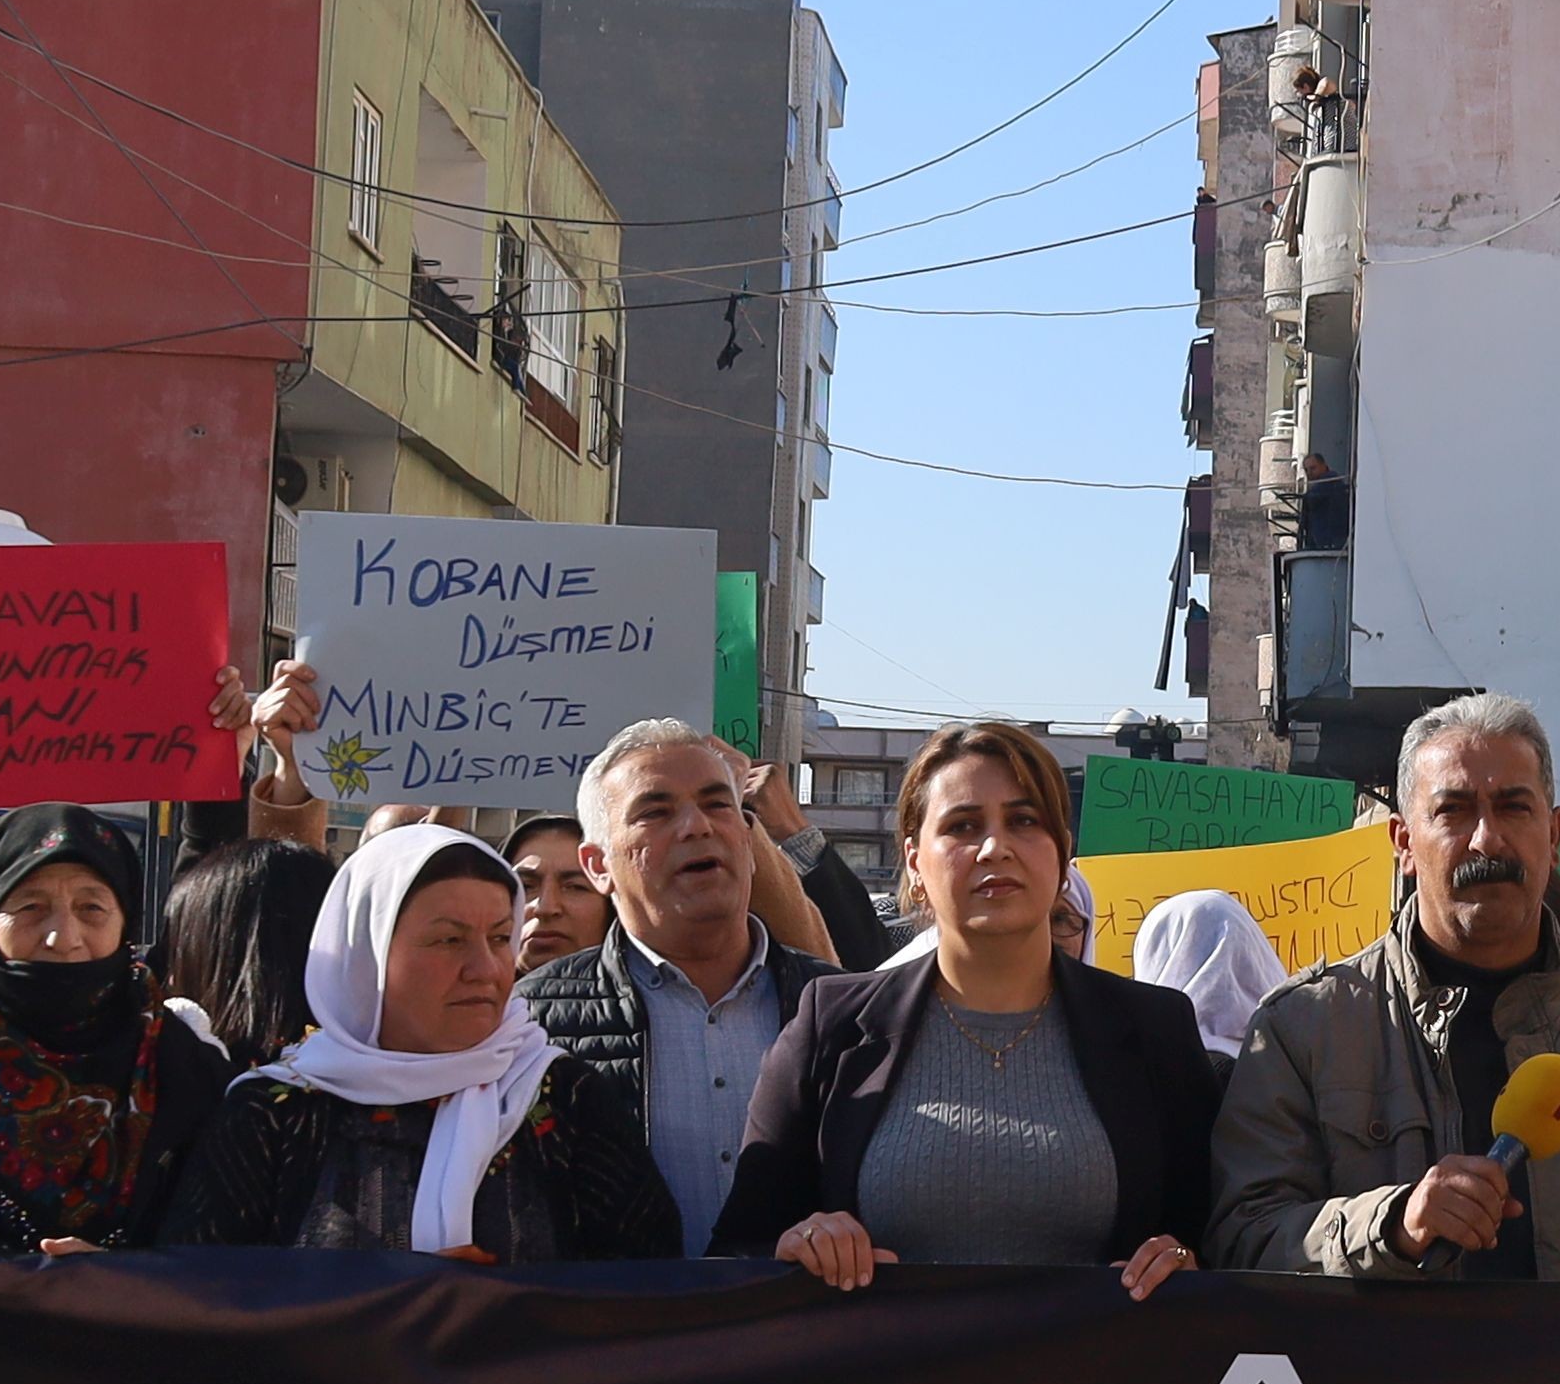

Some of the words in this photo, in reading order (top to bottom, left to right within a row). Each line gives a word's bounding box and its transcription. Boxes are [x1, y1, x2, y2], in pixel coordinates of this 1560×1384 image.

[353, 538, 599, 607] KOBANE
[459, 613, 655, 669] DÜŞMEDİ
[1243, 779, 1341, 827] HAYIR
